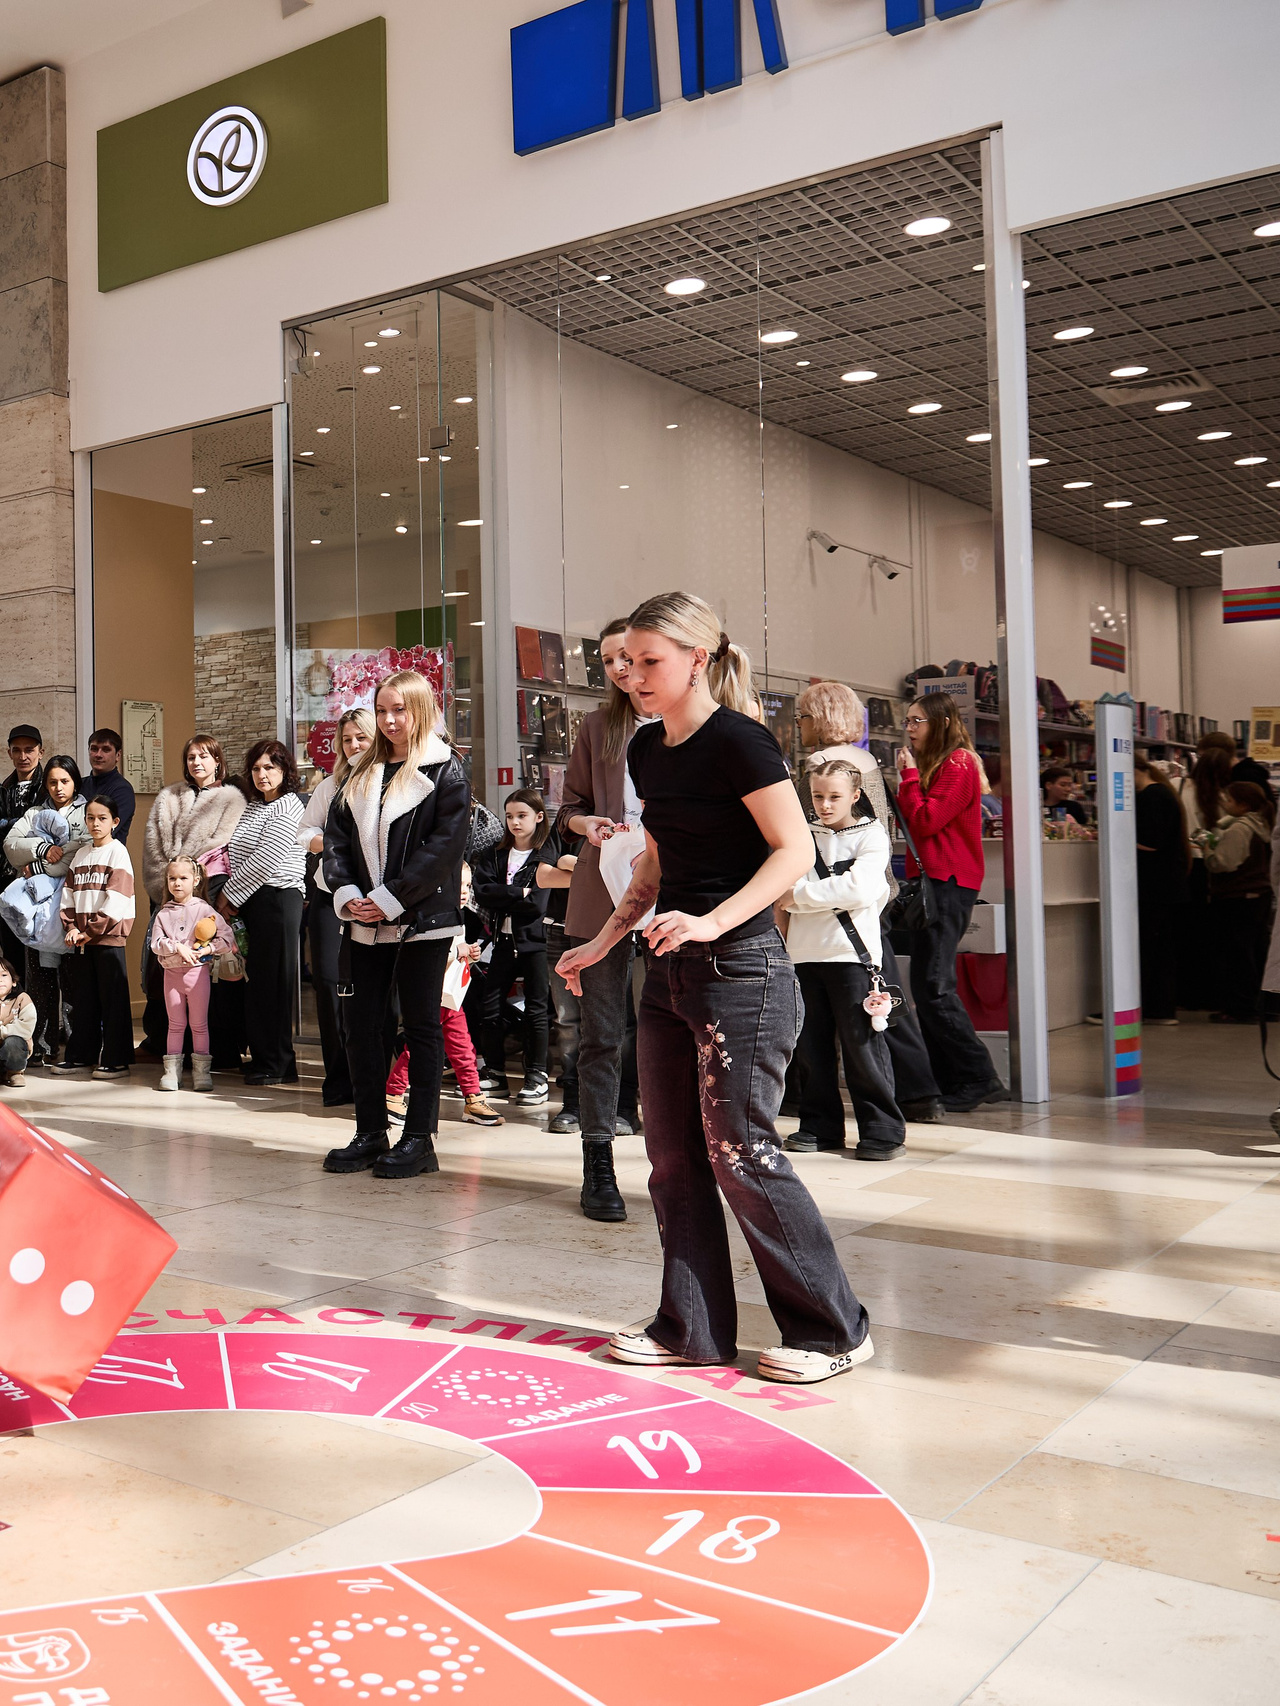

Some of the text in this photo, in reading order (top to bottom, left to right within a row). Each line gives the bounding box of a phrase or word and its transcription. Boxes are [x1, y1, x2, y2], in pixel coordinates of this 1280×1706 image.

[261, 1352, 371, 1393] 21
[400, 1401, 440, 1420] 20
[506, 1392, 630, 1428] ЗАДАНИЕ
[606, 1428, 703, 1480] 19
[644, 1508, 781, 1565] 18
[336, 1576, 395, 1595] 16
[90, 1606, 149, 1626] 15
[504, 1589, 721, 1638] 17
[206, 1620, 306, 1706] ЗАДАНИ
